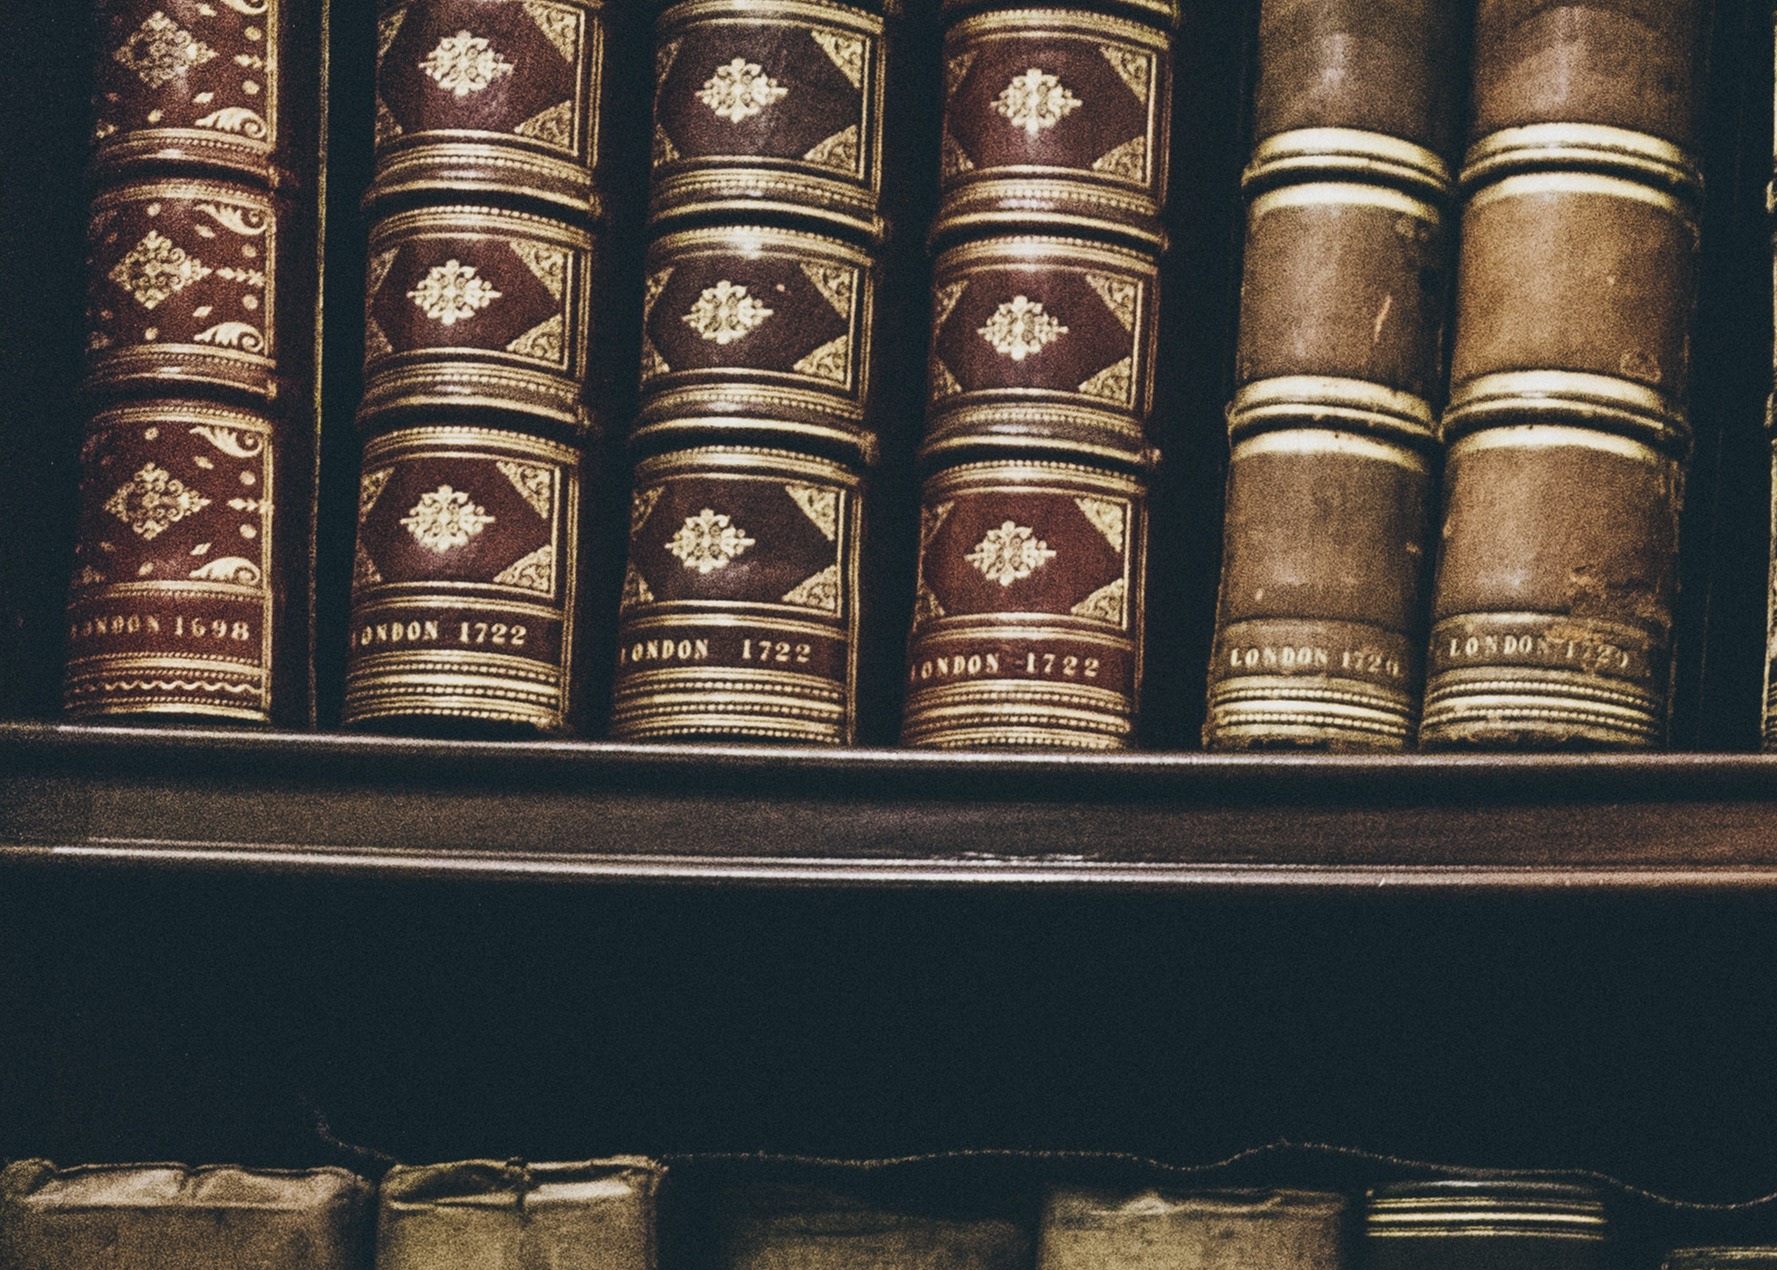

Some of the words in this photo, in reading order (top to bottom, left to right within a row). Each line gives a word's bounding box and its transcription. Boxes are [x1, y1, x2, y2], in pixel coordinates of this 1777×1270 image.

[174, 614, 249, 642] 1698
[459, 621, 527, 646] 1722
[742, 639, 810, 662] 1722
[1231, 648, 1328, 667] LONDON
[1450, 636, 1550, 658] LONDON
[1025, 653, 1100, 677] 1722
